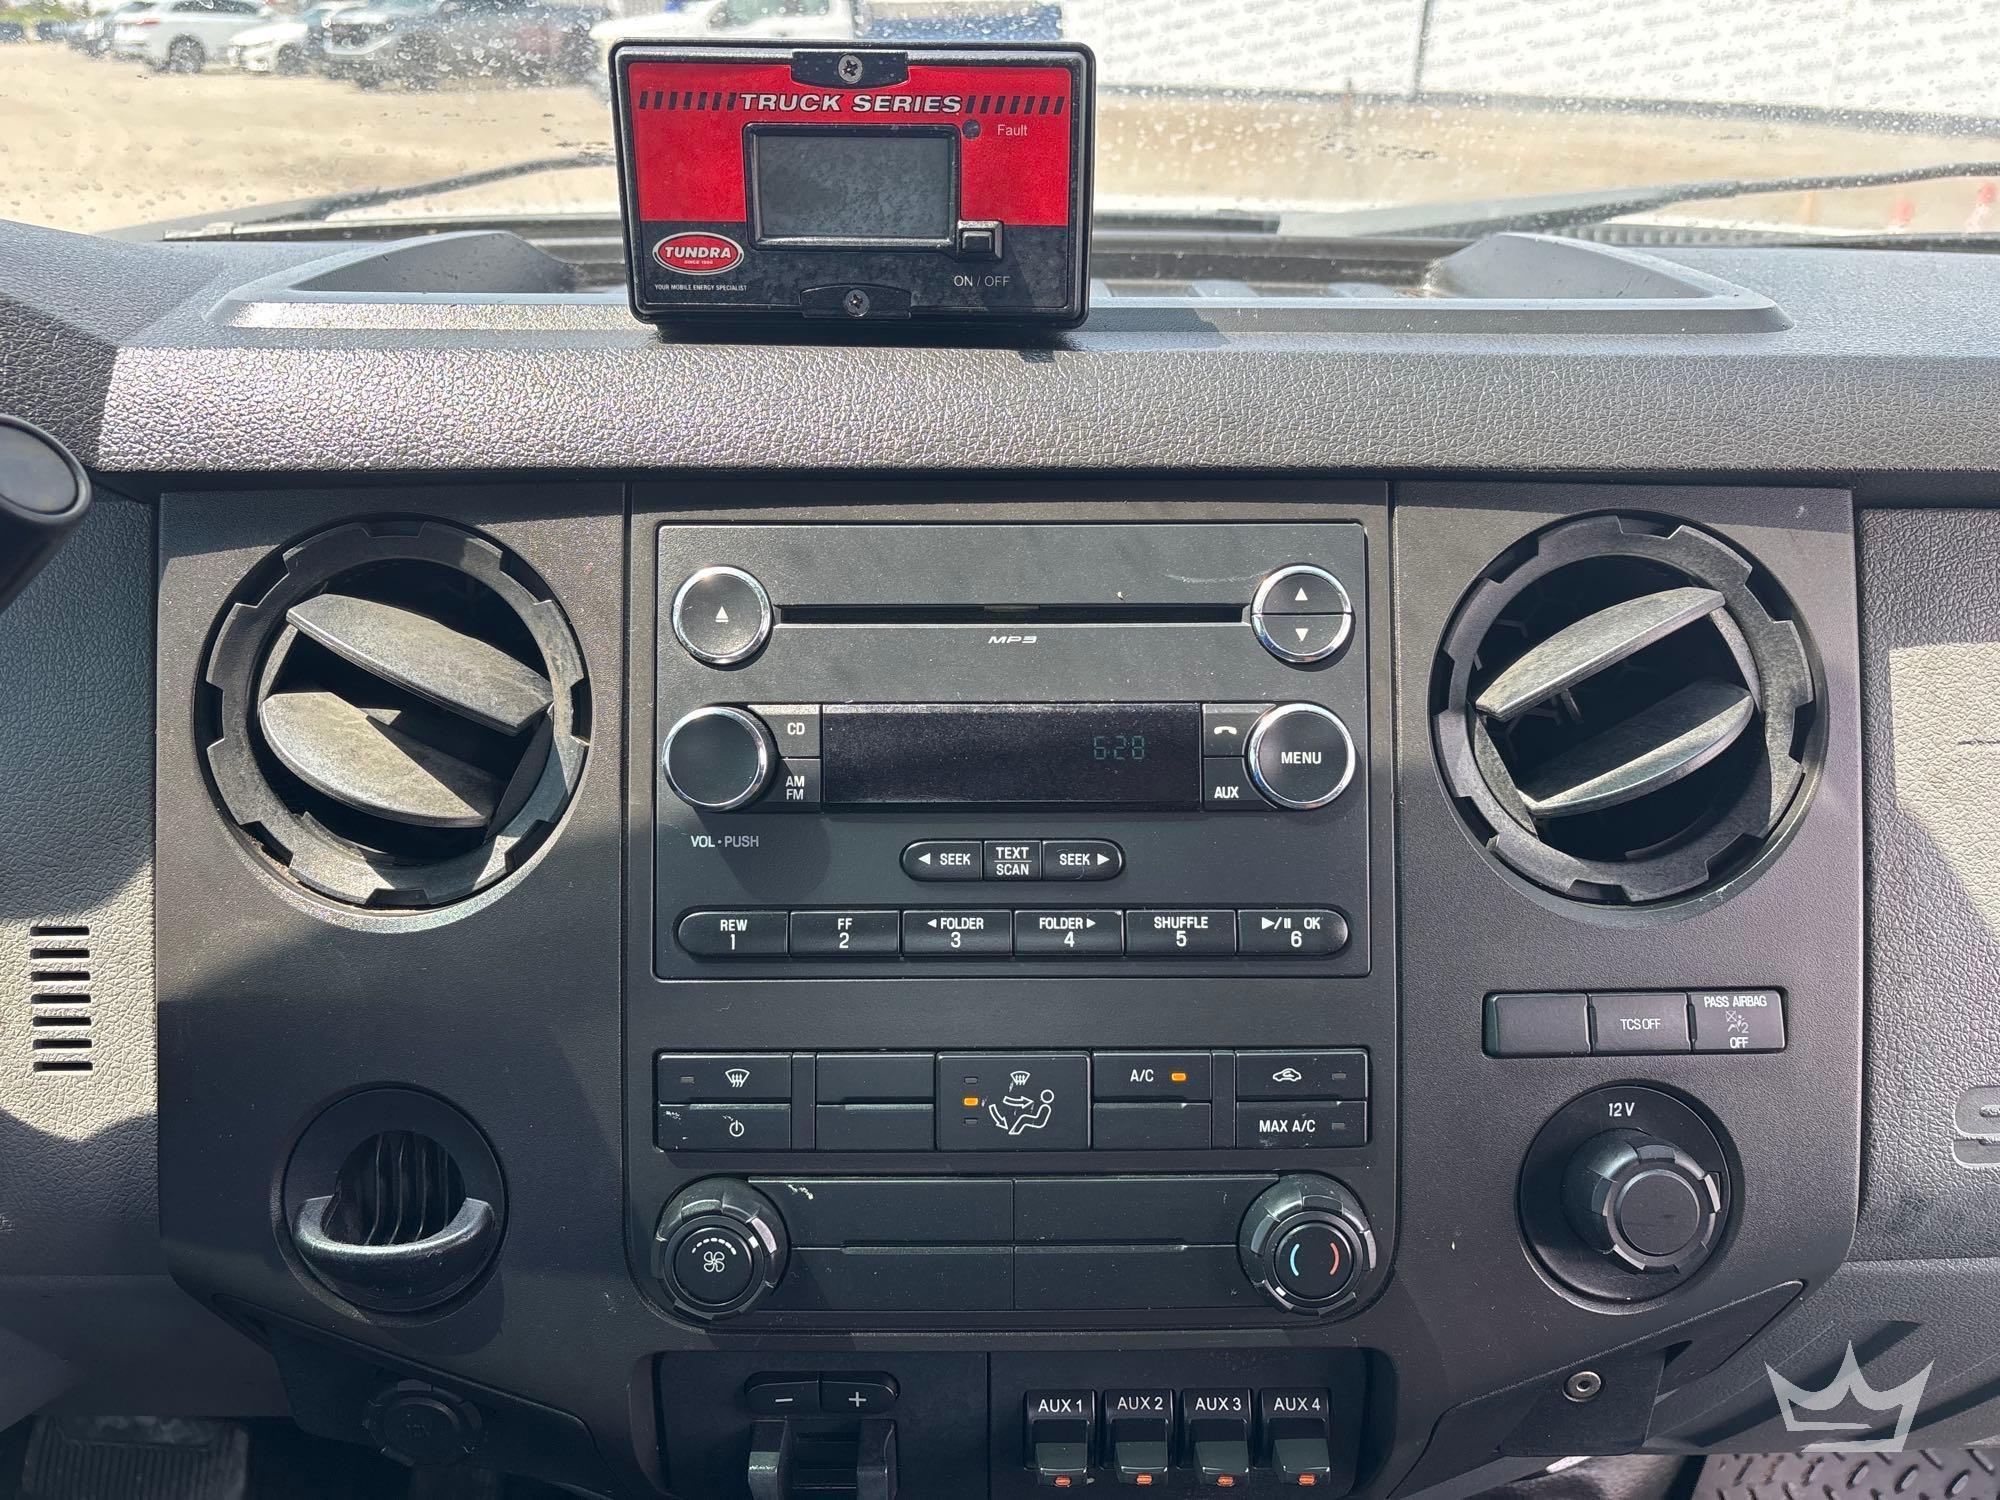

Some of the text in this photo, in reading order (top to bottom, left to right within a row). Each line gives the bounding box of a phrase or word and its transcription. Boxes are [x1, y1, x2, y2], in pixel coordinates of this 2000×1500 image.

[740, 94, 962, 114] TRUCK SERIES
[997, 123, 1028, 137] Fault
[664, 246, 732, 259] TUNDRA
[654, 283, 748, 292] YOUR MOBILE ENERGY SPECIALIST
[953, 275, 973, 287] ON
[984, 275, 1011, 287] OFF
[987, 635, 1038, 644] MP3
[787, 722, 806, 736] CD
[1280, 751, 1322, 765] MENU
[785, 775, 805, 788] AM
[786, 788, 804, 800] FM
[1213, 786, 1240, 799] AUX
[690, 835, 760, 848] VOL PUSH
[939, 852, 971, 866] SEEK
[995, 846, 1030, 860] TEXT
[1059, 853, 1091, 866] SEEK
[996, 863, 1029, 876] SCAN
[720, 919, 748, 932] REW
[837, 917, 853, 930] FF
[940, 917, 984, 930] FOLDER
[1039, 916, 1084, 930] FOLDER
[1153, 916, 1209, 929] SHUFFLE
[1303, 916, 1321, 930] OK
[730, 933, 736, 950] 1
[838, 932, 850, 949] 2
[950, 931, 962, 949] 3
[1063, 931, 1076, 948] 4
[1176, 930, 1188, 947] 5
[1290, 930, 1303, 948] 6
[1703, 995, 1768, 1008] PASS AIRBAG
[1619, 1018, 1662, 1031] TCS OFF
[1729, 1036, 1749, 1049] OFF
[1129, 1068, 1154, 1082] A/C
[1259, 1119, 1316, 1133] MAX A/C
[1037, 1398, 1082, 1413] AUX 1
[1117, 1396, 1164, 1410] AUX 2
[1195, 1397, 1242, 1411] AUX 3
[1273, 1397, 1321, 1411] AUX 4
